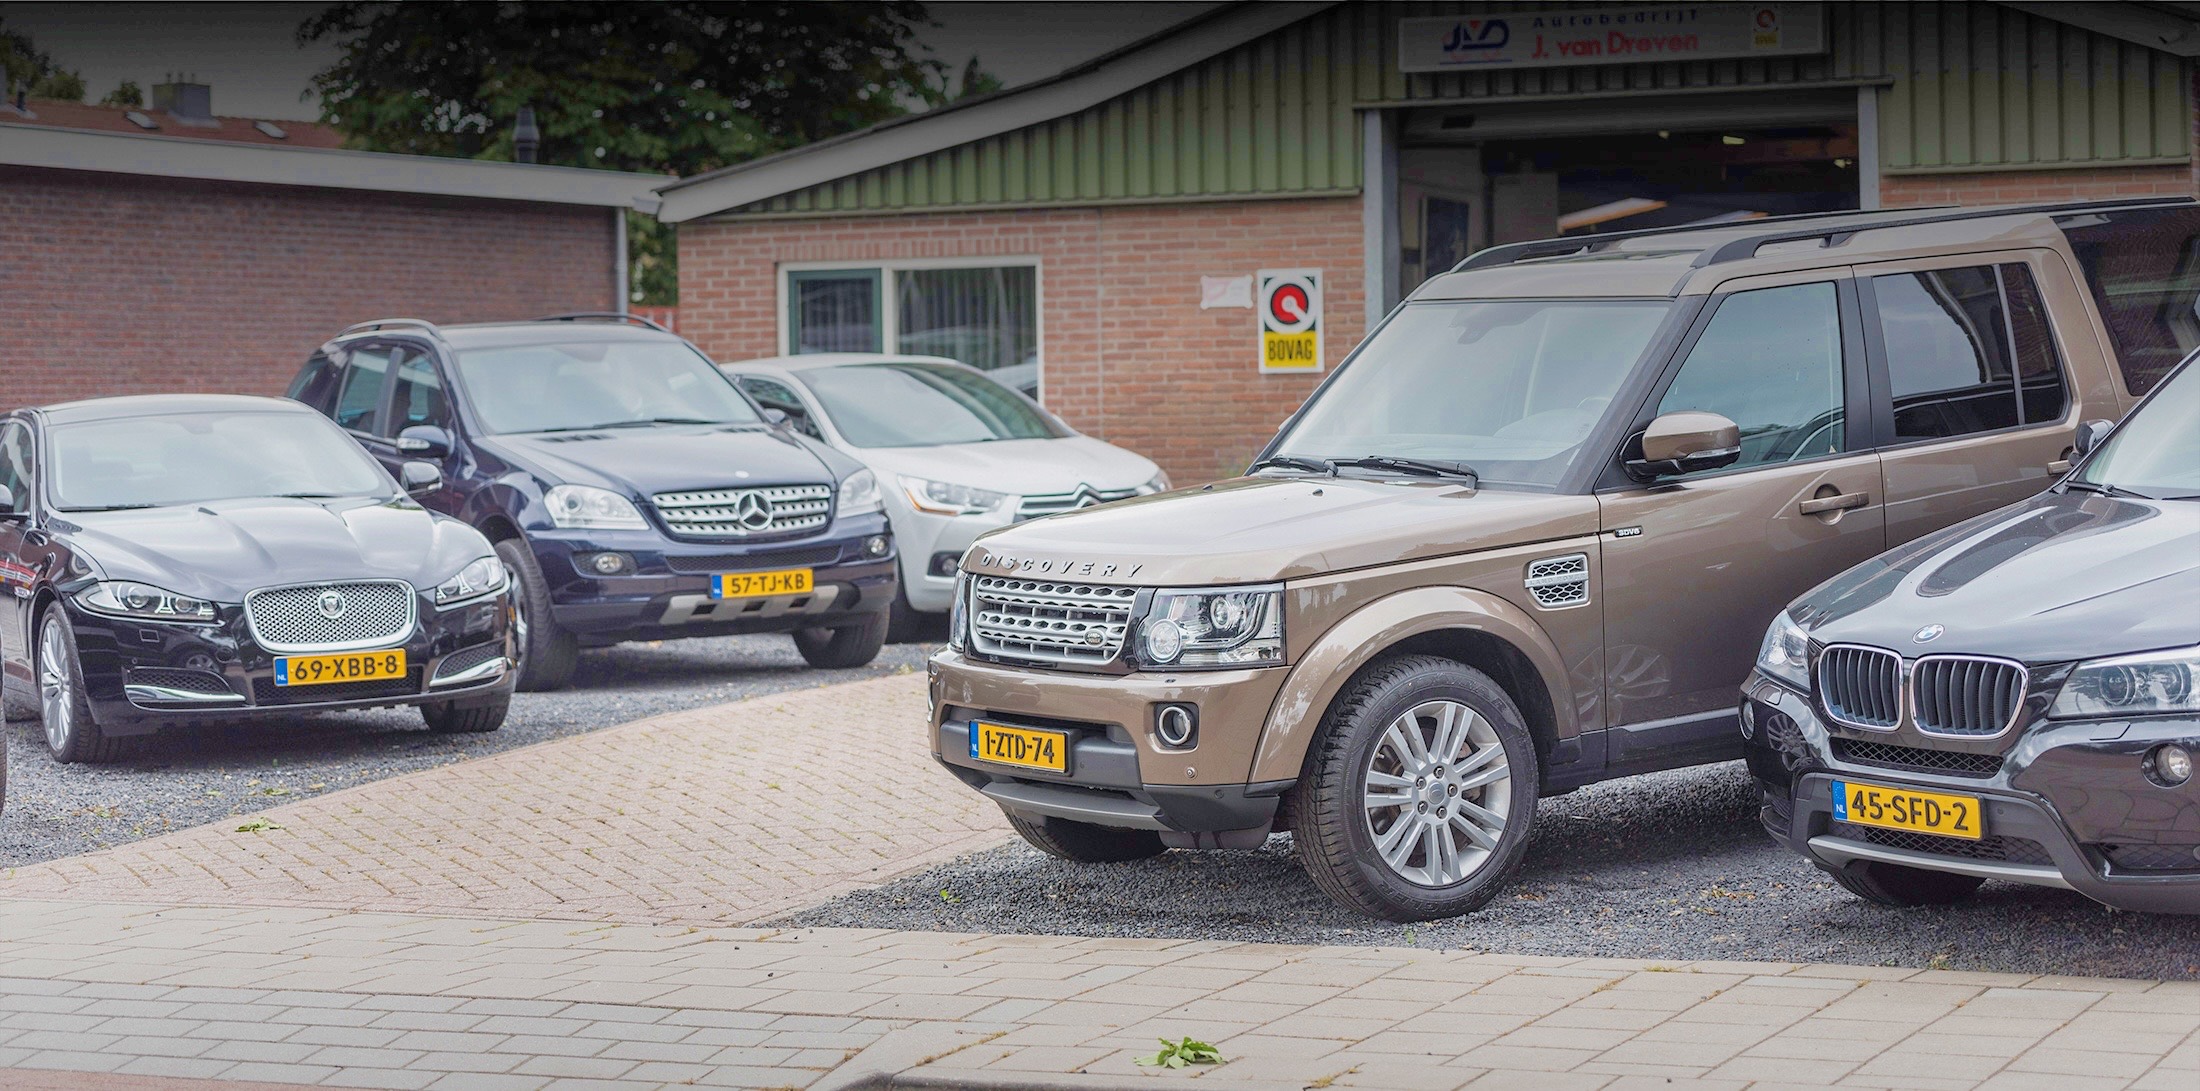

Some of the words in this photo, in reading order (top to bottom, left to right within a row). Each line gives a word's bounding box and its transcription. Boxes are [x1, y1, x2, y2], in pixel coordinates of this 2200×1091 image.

[1531, 34, 1549, 59] J.
[1556, 37, 1602, 57] van
[1268, 339, 1313, 361] BOVAG
[980, 553, 1143, 578] DISCOVERY
[731, 573, 805, 594] 57-TJ-KB
[295, 655, 397, 680] 69-XBB-8
[985, 730, 1055, 764] 1-ZTD-74
[1836, 804, 1846, 814] NL
[1852, 790, 1969, 831] 45-SFD-2
